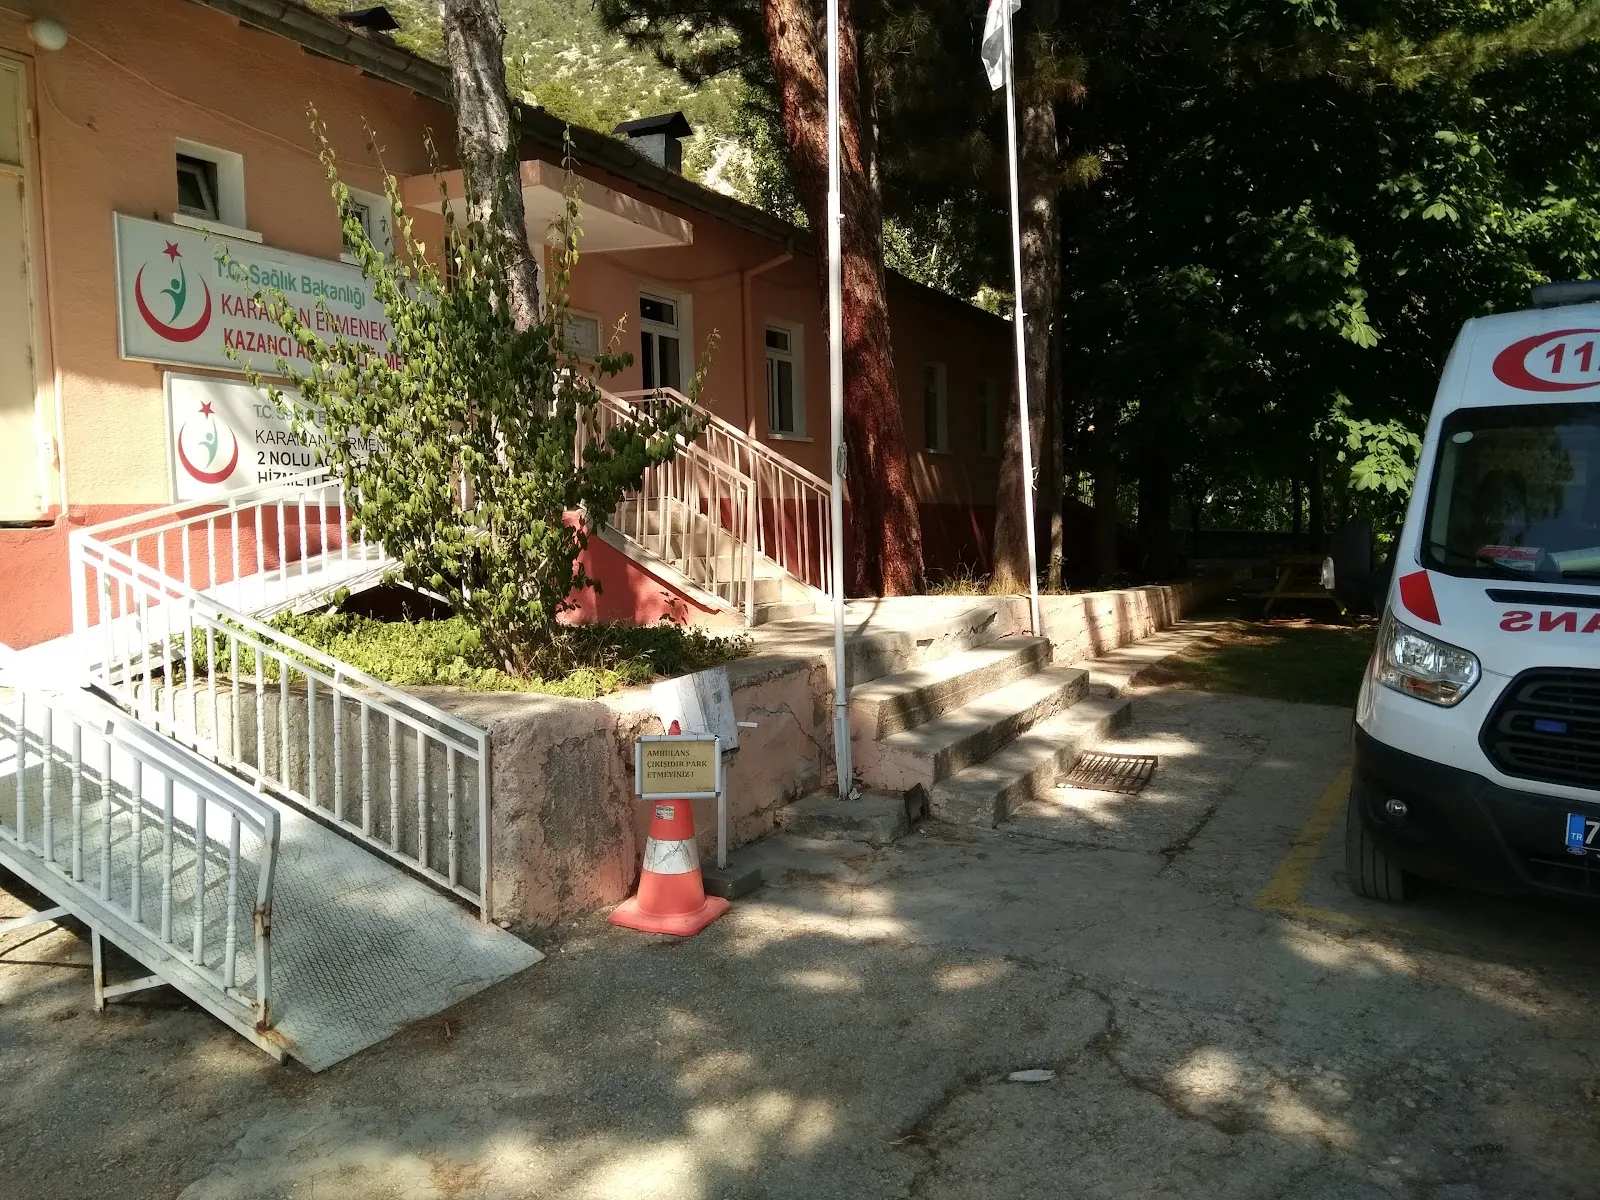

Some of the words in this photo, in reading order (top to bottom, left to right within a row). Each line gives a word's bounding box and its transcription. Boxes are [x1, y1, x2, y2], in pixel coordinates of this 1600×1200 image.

[214, 256, 244, 281] T.C.
[249, 264, 297, 292] Sağlık
[301, 275, 365, 310] Bakanlığı
[221, 293, 311, 329] KARAMN
[223, 327, 292, 357] KAZANCI
[1545, 341, 1600, 373] 11
[253, 404, 274, 419] T.C.
[257, 451, 266, 465] 2
[269, 451, 310, 467] NOLU
[646, 760, 684, 769] ÇIKIŞIDIR
[647, 770, 690, 779] ETMEYİNİZ
[1571, 832, 1583, 841] TR
